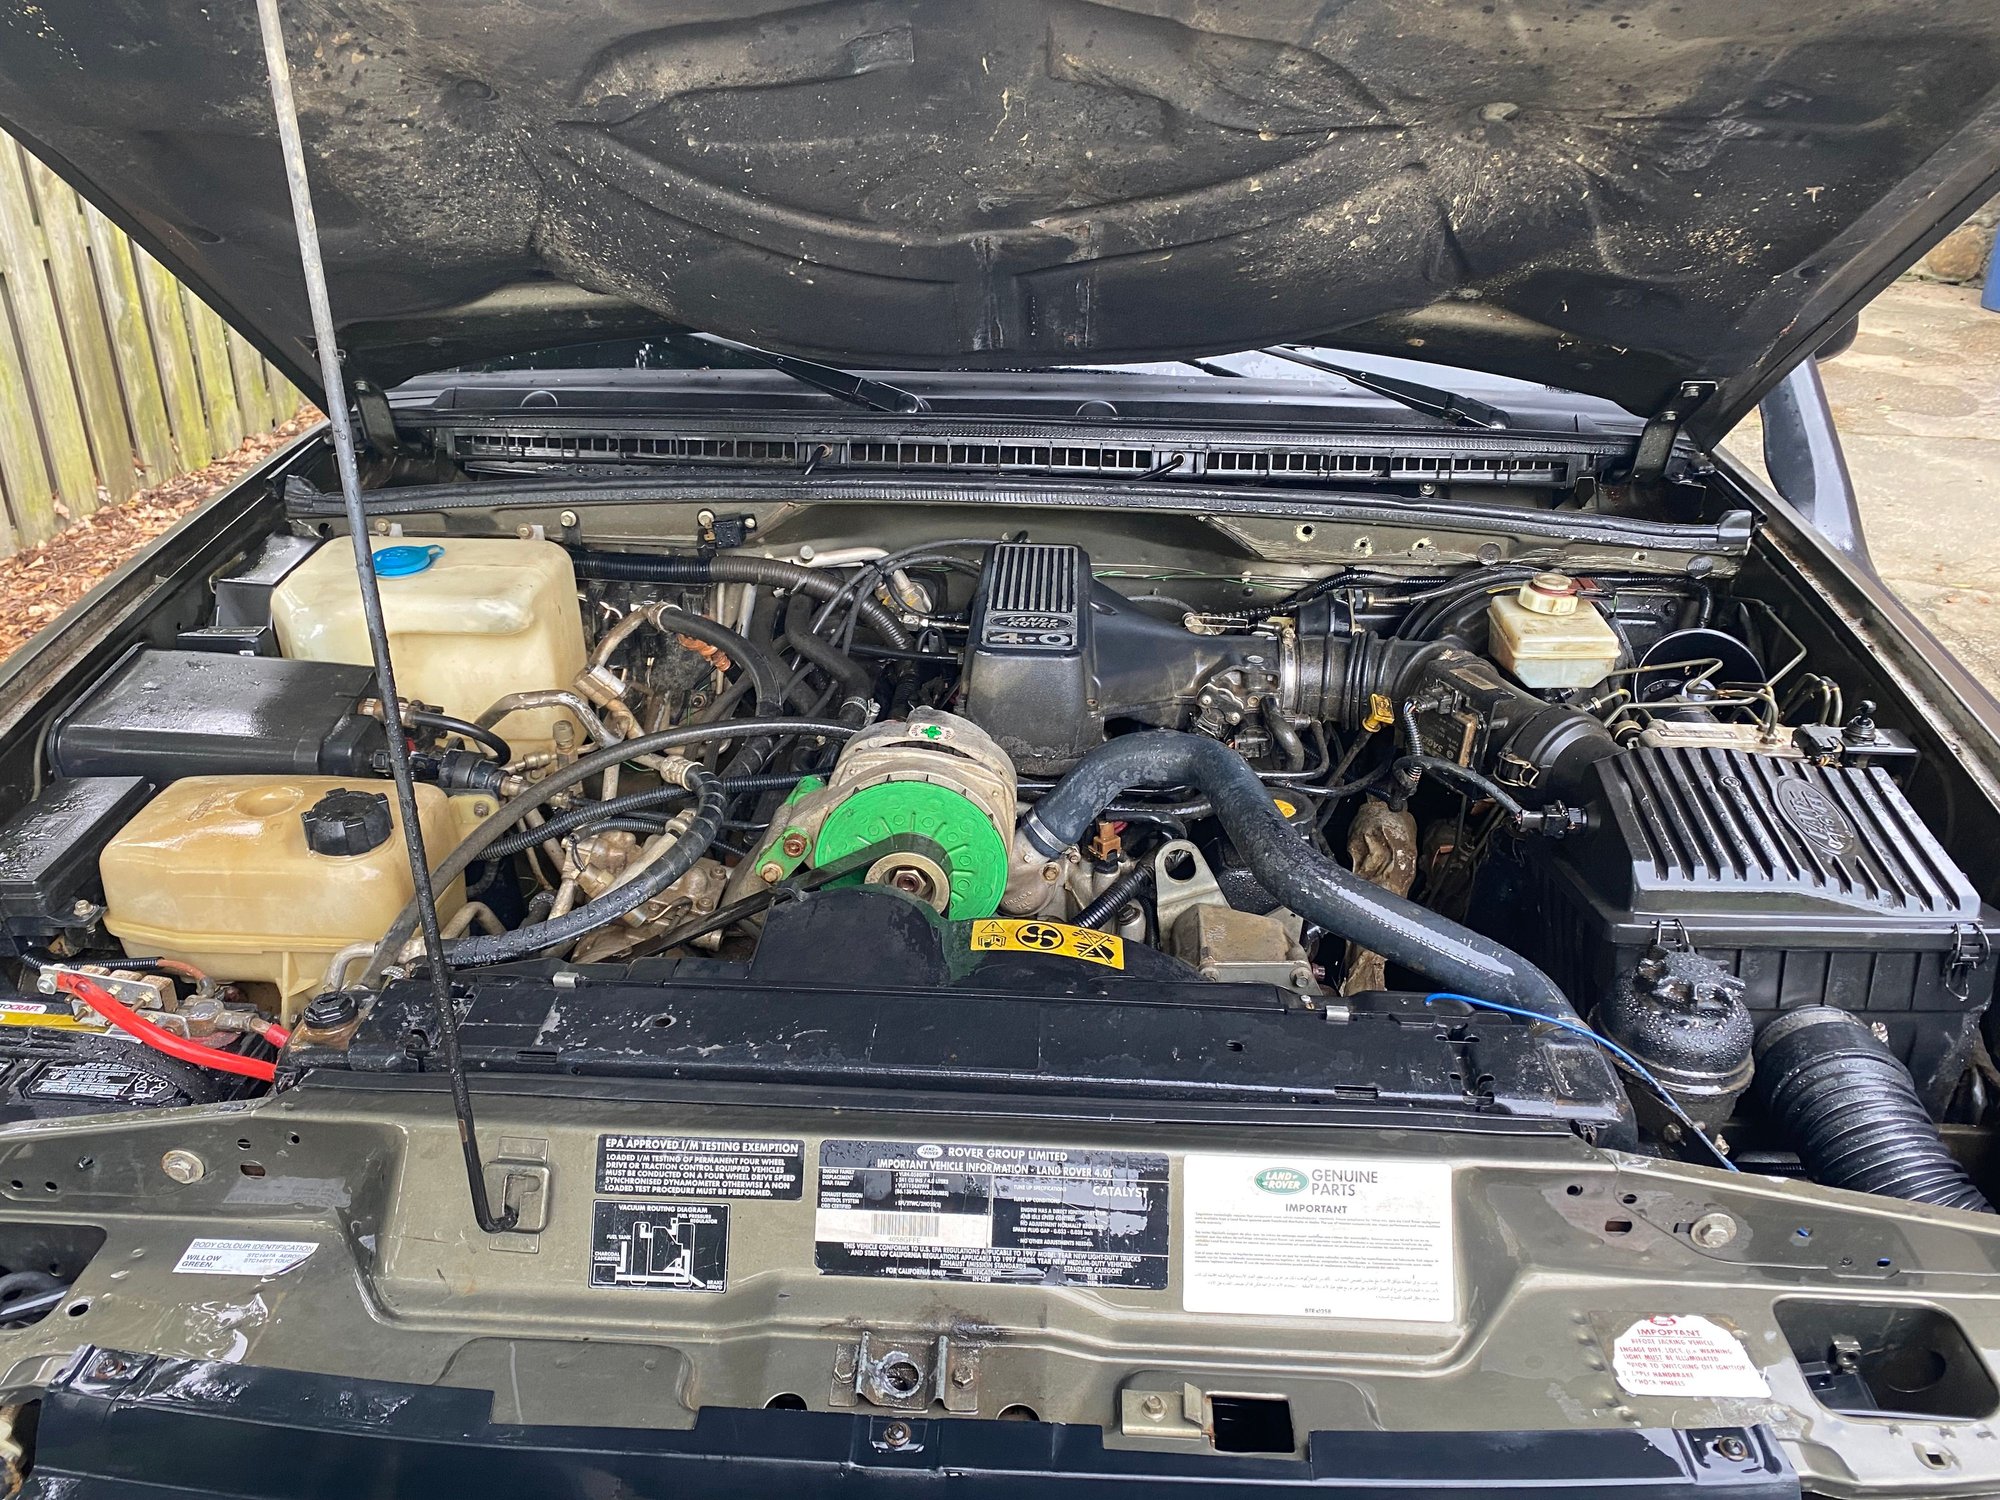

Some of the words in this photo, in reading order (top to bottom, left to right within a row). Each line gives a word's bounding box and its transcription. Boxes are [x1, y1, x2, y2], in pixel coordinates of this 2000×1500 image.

[606, 1138, 624, 1148] EPA
[626, 1140, 678, 1150] APPROVED
[682, 1140, 699, 1152] I/M
[701, 1142, 740, 1152] TESTING
[742, 1142, 798, 1154] EXEMPTION
[948, 1148, 984, 1158] ROVER
[986, 1149, 1026, 1159] GROUP
[1028, 1152, 1068, 1162] LIMITED
[877, 1158, 928, 1170] IMPORTANT
[930, 1160, 964, 1172] VEHICLE
[966, 1162, 1028, 1174] INFORMATION
[1036, 1166, 1062, 1176] LAND
[1063, 1168, 1092, 1177] ROVER
[1094, 1168, 1113, 1178] 4.0L
[605, 1176, 662, 1185] SYNCHRONISED
[664, 1179, 720, 1187] DYNAMOMETER
[1265, 1172, 1294, 1182] LAND
[1312, 1168, 1378, 1184] GENUINE
[1267, 1180, 1301, 1190] ROVER
[1312, 1183, 1356, 1196] PARTS
[1092, 1186, 1148, 1198] CATALYST
[677, 1206, 708, 1214] DIAGRAM
[1285, 1203, 1348, 1214] IMPORTANT
[252, 1243, 314, 1252] IDENTIFICATION
